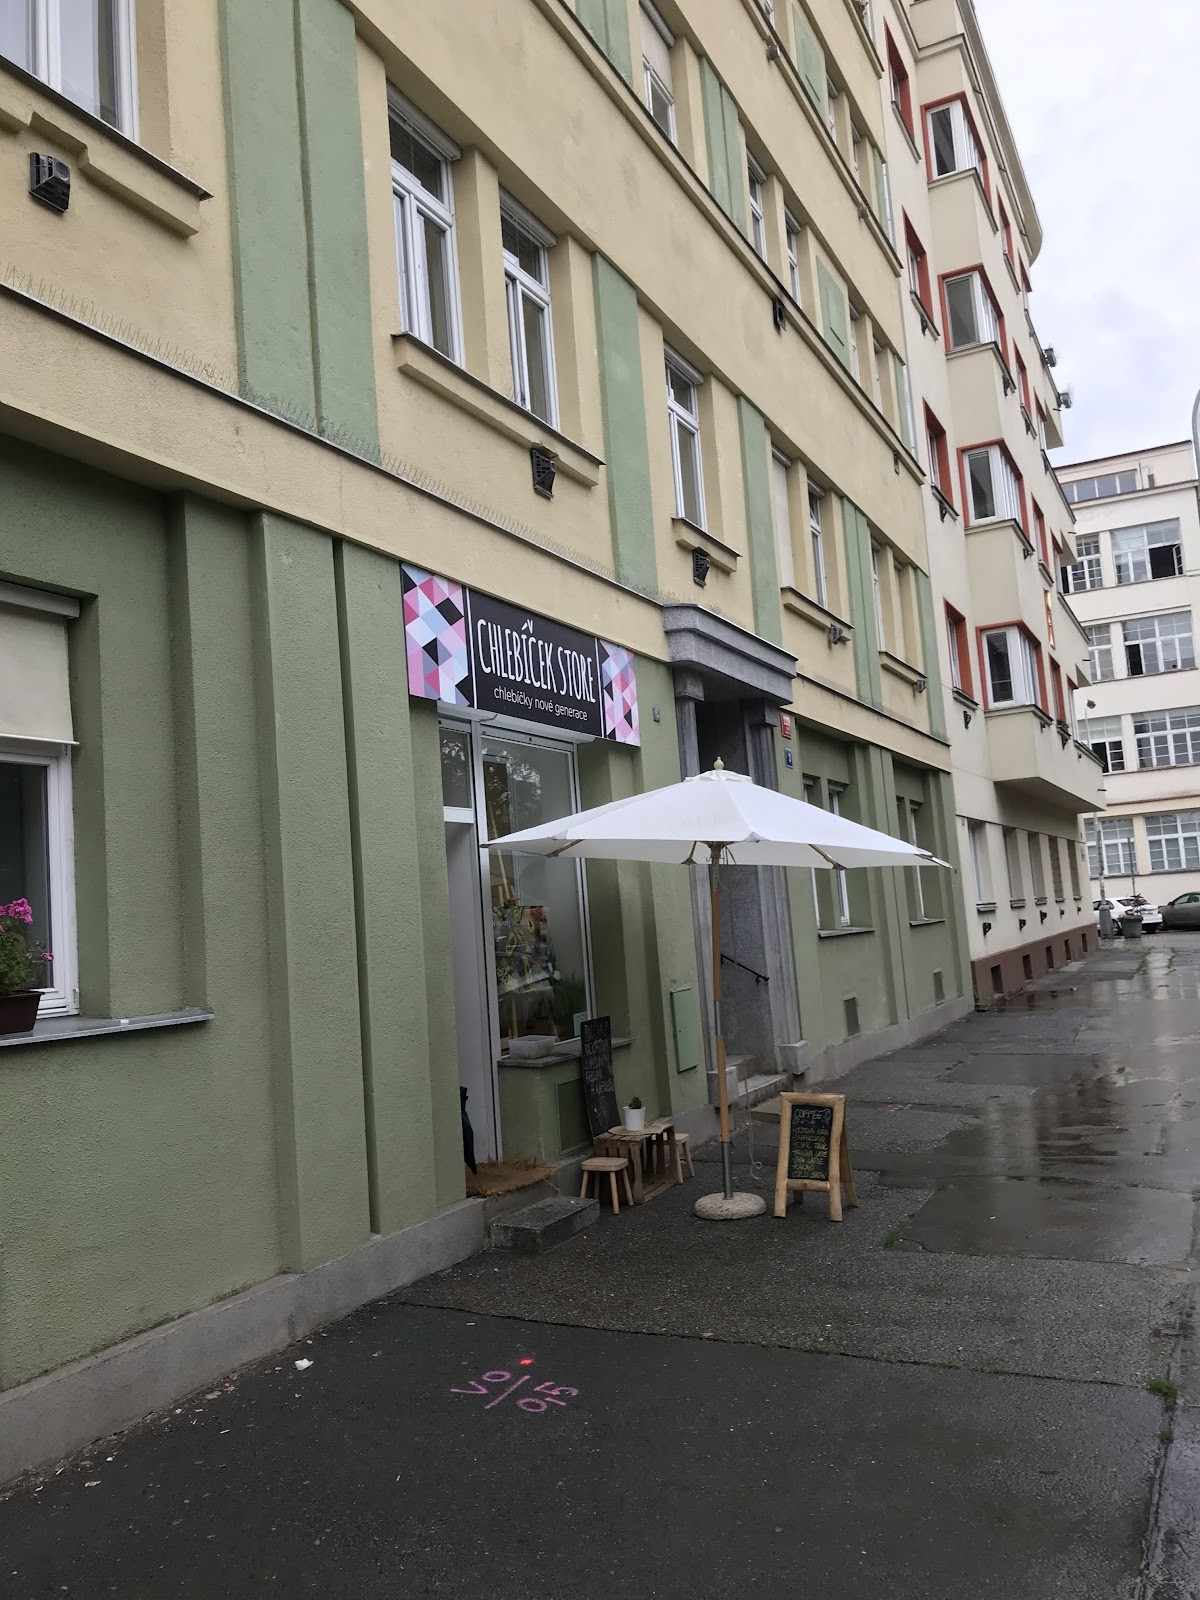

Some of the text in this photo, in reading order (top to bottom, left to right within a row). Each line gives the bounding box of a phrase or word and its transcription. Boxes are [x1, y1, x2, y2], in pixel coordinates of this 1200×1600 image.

[477, 618, 596, 703] CHLEBÍČEK STORE
[494, 685, 588, 721] chlebíčky nové generace
